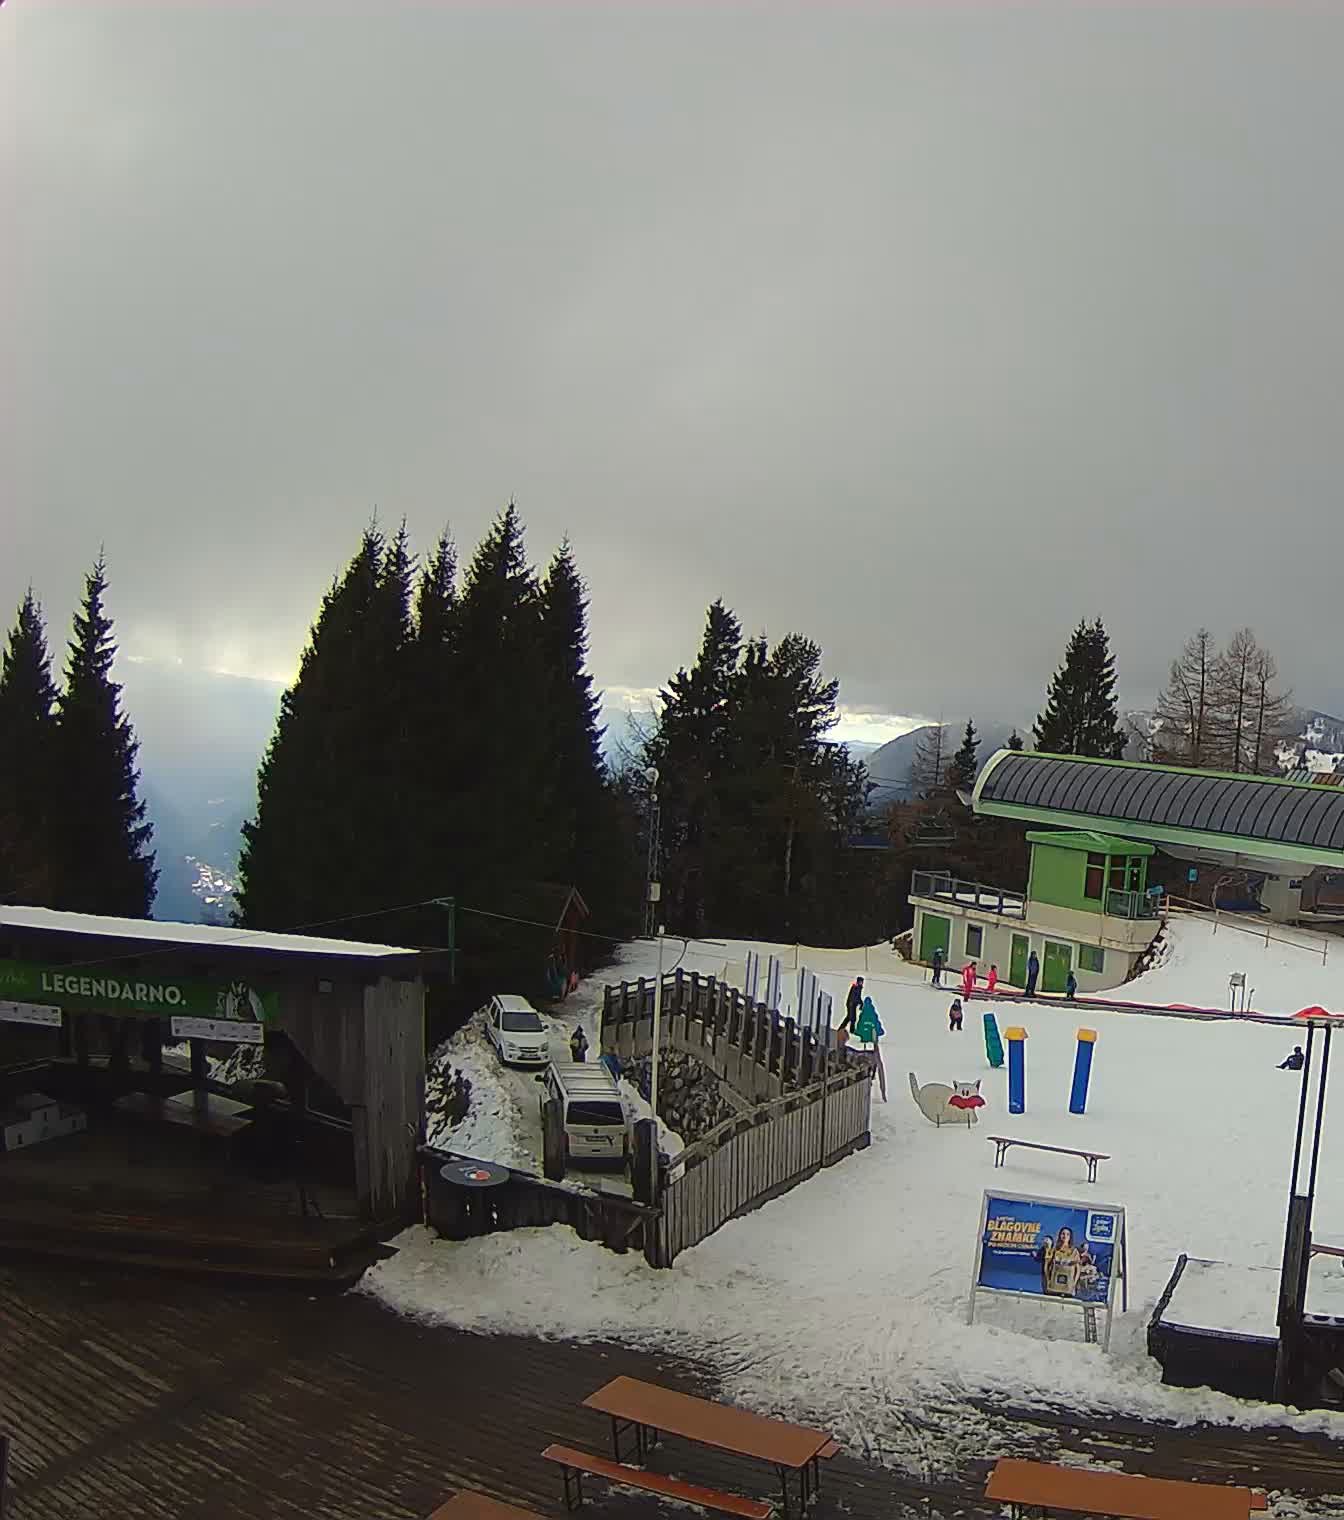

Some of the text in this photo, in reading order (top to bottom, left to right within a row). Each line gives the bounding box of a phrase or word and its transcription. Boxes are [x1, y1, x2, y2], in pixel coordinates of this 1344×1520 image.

[41, 972, 188, 1006] LEGENDARNO.
[987, 1220, 1041, 1233] BLAGOVNE
[990, 1231, 1037, 1243] ZNAMKE
